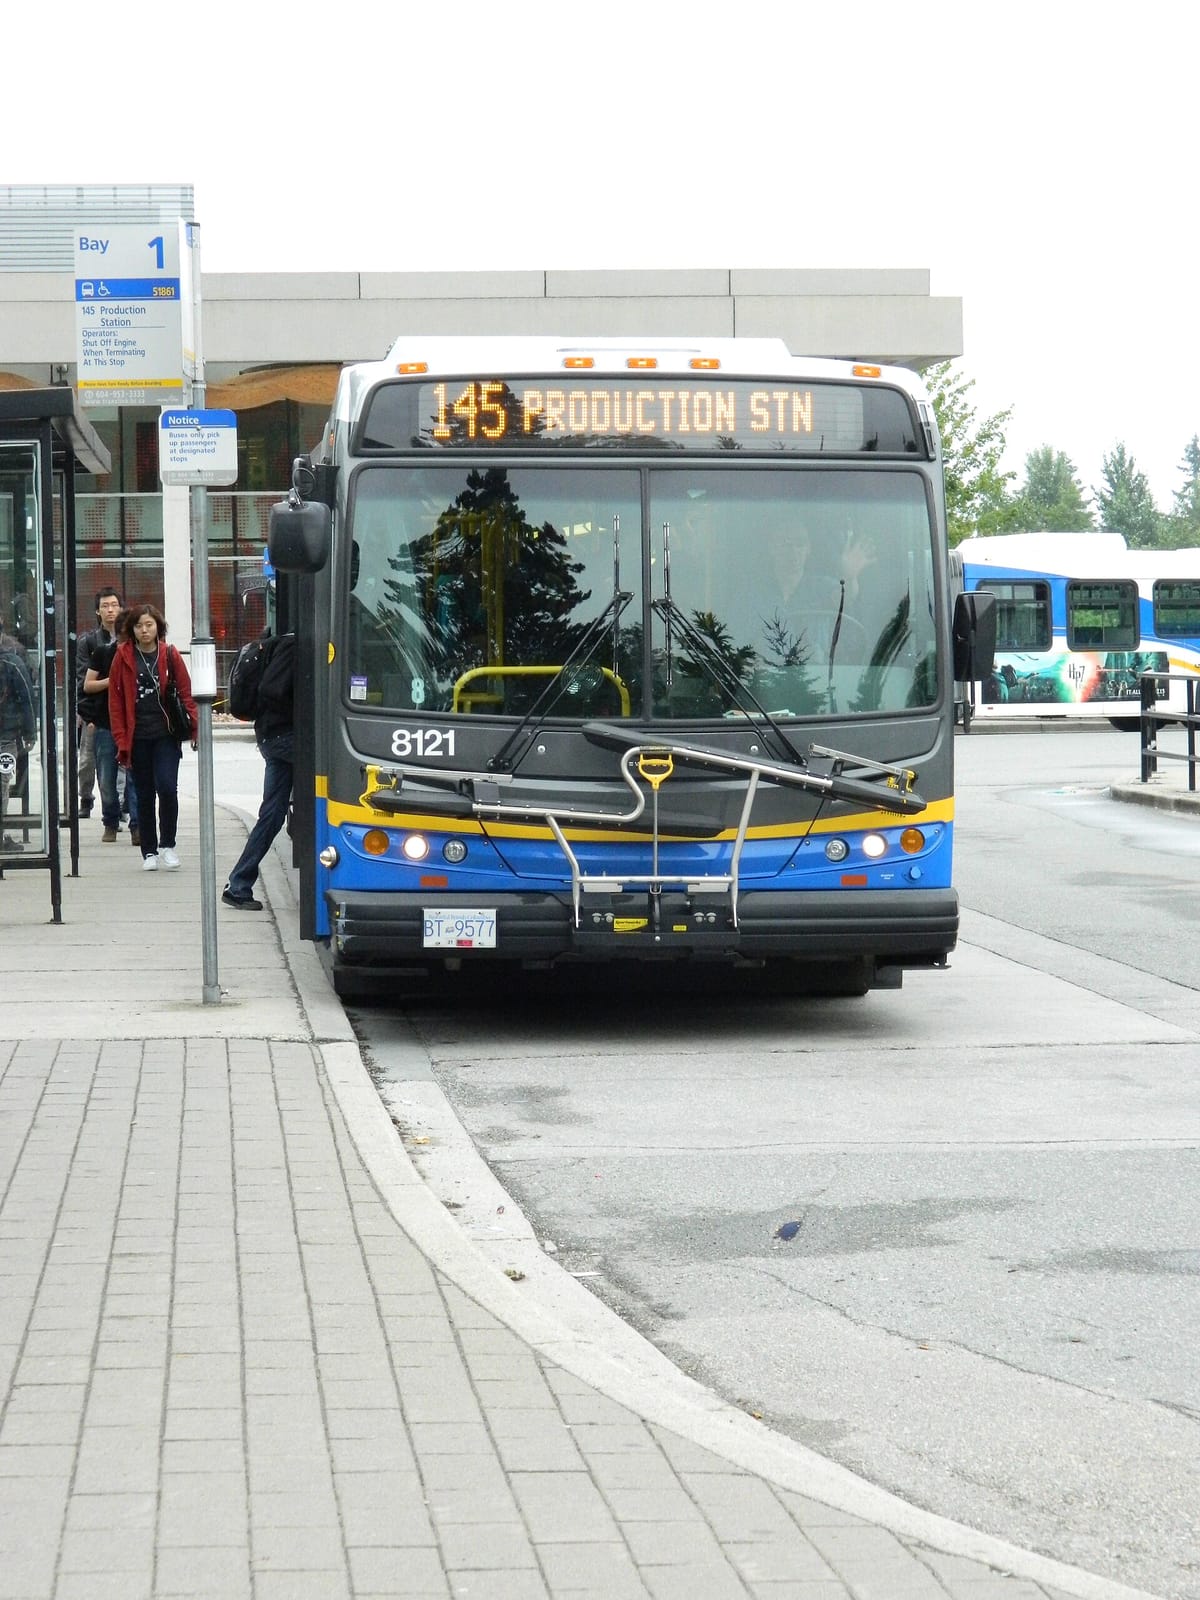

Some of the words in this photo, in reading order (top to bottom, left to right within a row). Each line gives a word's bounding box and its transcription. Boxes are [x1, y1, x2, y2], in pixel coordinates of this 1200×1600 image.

[79, 237, 109, 254] Bay
[147, 236, 164, 269] 1
[153, 286, 175, 296] 51861
[82, 306, 95, 315] 145
[100, 305, 146, 315] Production
[100, 317, 131, 327] Station
[82, 329, 118, 339] Operators:
[82, 339, 98, 347] Shut
[114, 339, 137, 348] Engine
[106, 348, 145, 357] Terminating
[94, 358, 107, 366] This
[110, 358, 125, 367] Stop
[433, 383, 506, 438] 145
[523, 391, 735, 431] PRODUCTION
[750, 391, 812, 432] STN
[168, 416, 199, 424] Notice
[179, 447, 216, 455] designated
[411, 677, 425, 704] 8
[391, 729, 455, 756] 8121
[424, 919, 444, 937] BT
[455, 919, 495, 937] 9577
